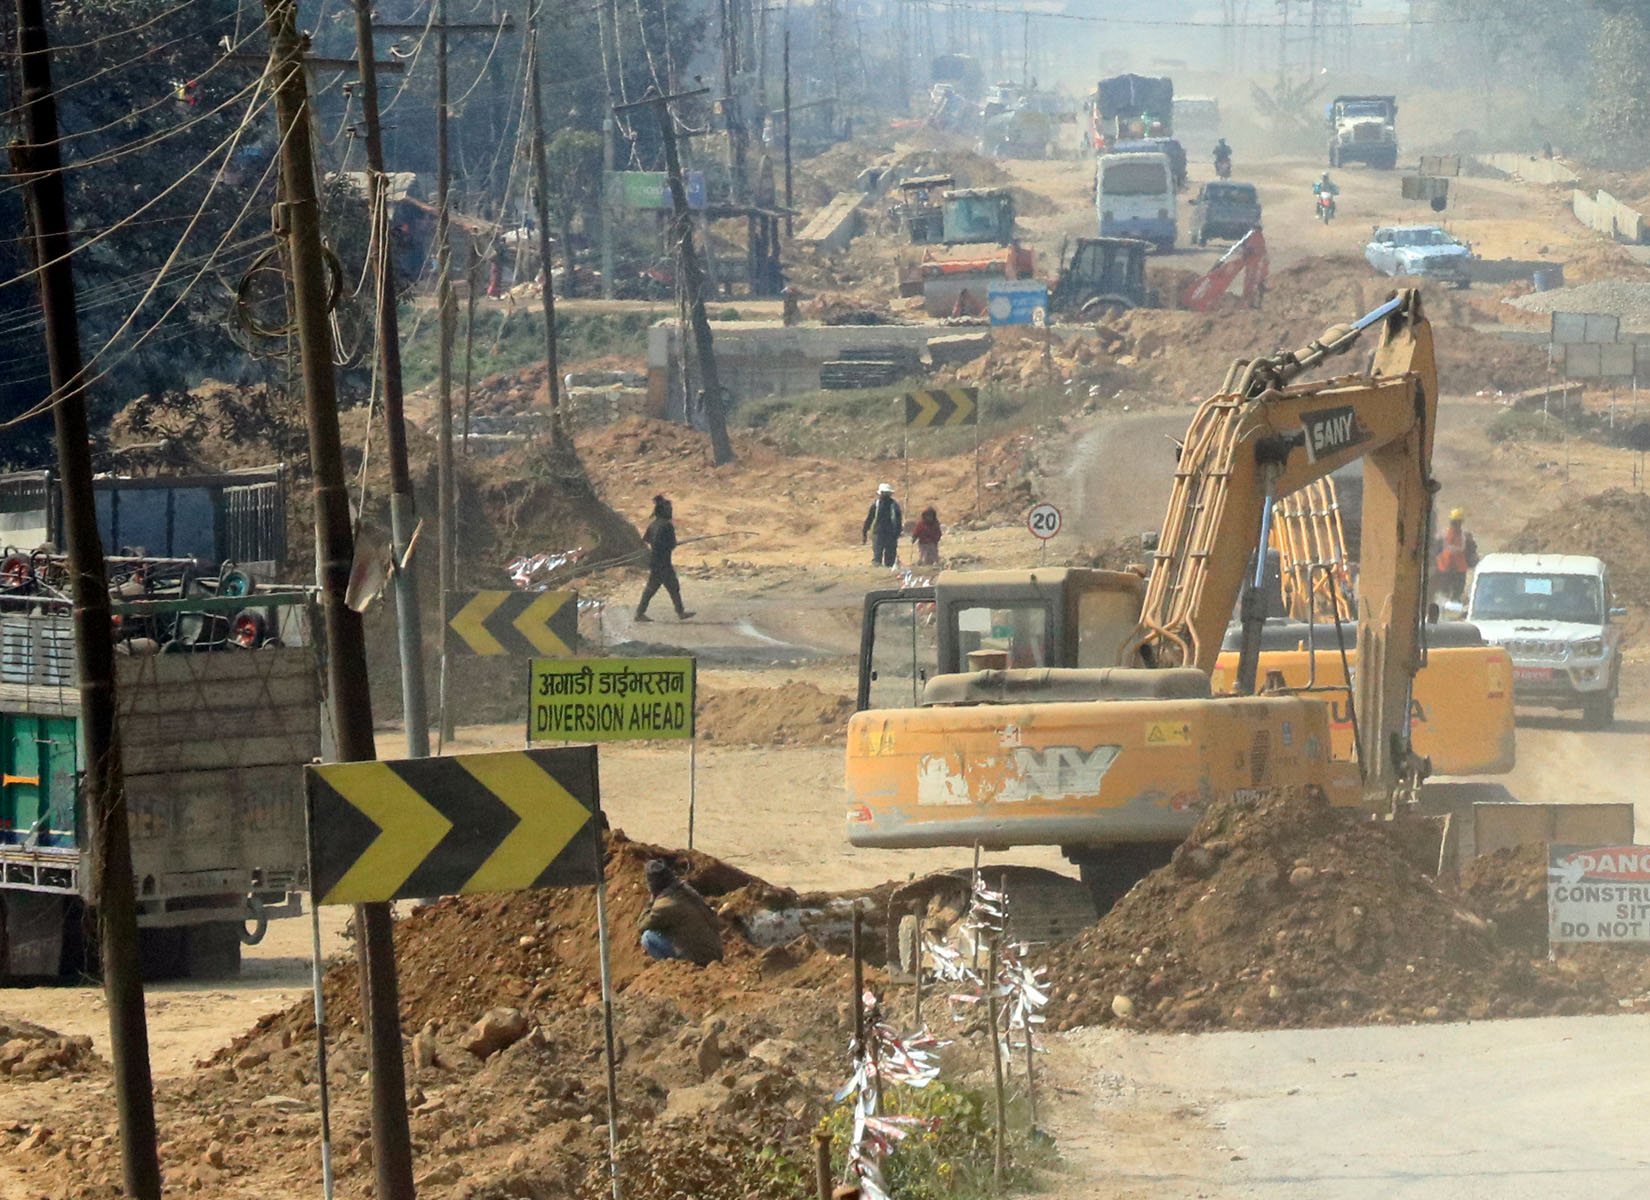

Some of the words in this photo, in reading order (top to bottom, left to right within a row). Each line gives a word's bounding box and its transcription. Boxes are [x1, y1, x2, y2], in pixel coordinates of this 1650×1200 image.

[1313, 411, 1354, 451] SANY
[1033, 512, 1057, 531] 20
[539, 665, 594, 696] अगाडी
[537, 703, 624, 732] DIVERSION
[628, 702, 685, 731] AHEAD
[1560, 921, 1590, 938] DO
[1597, 922, 1642, 938] NOT
